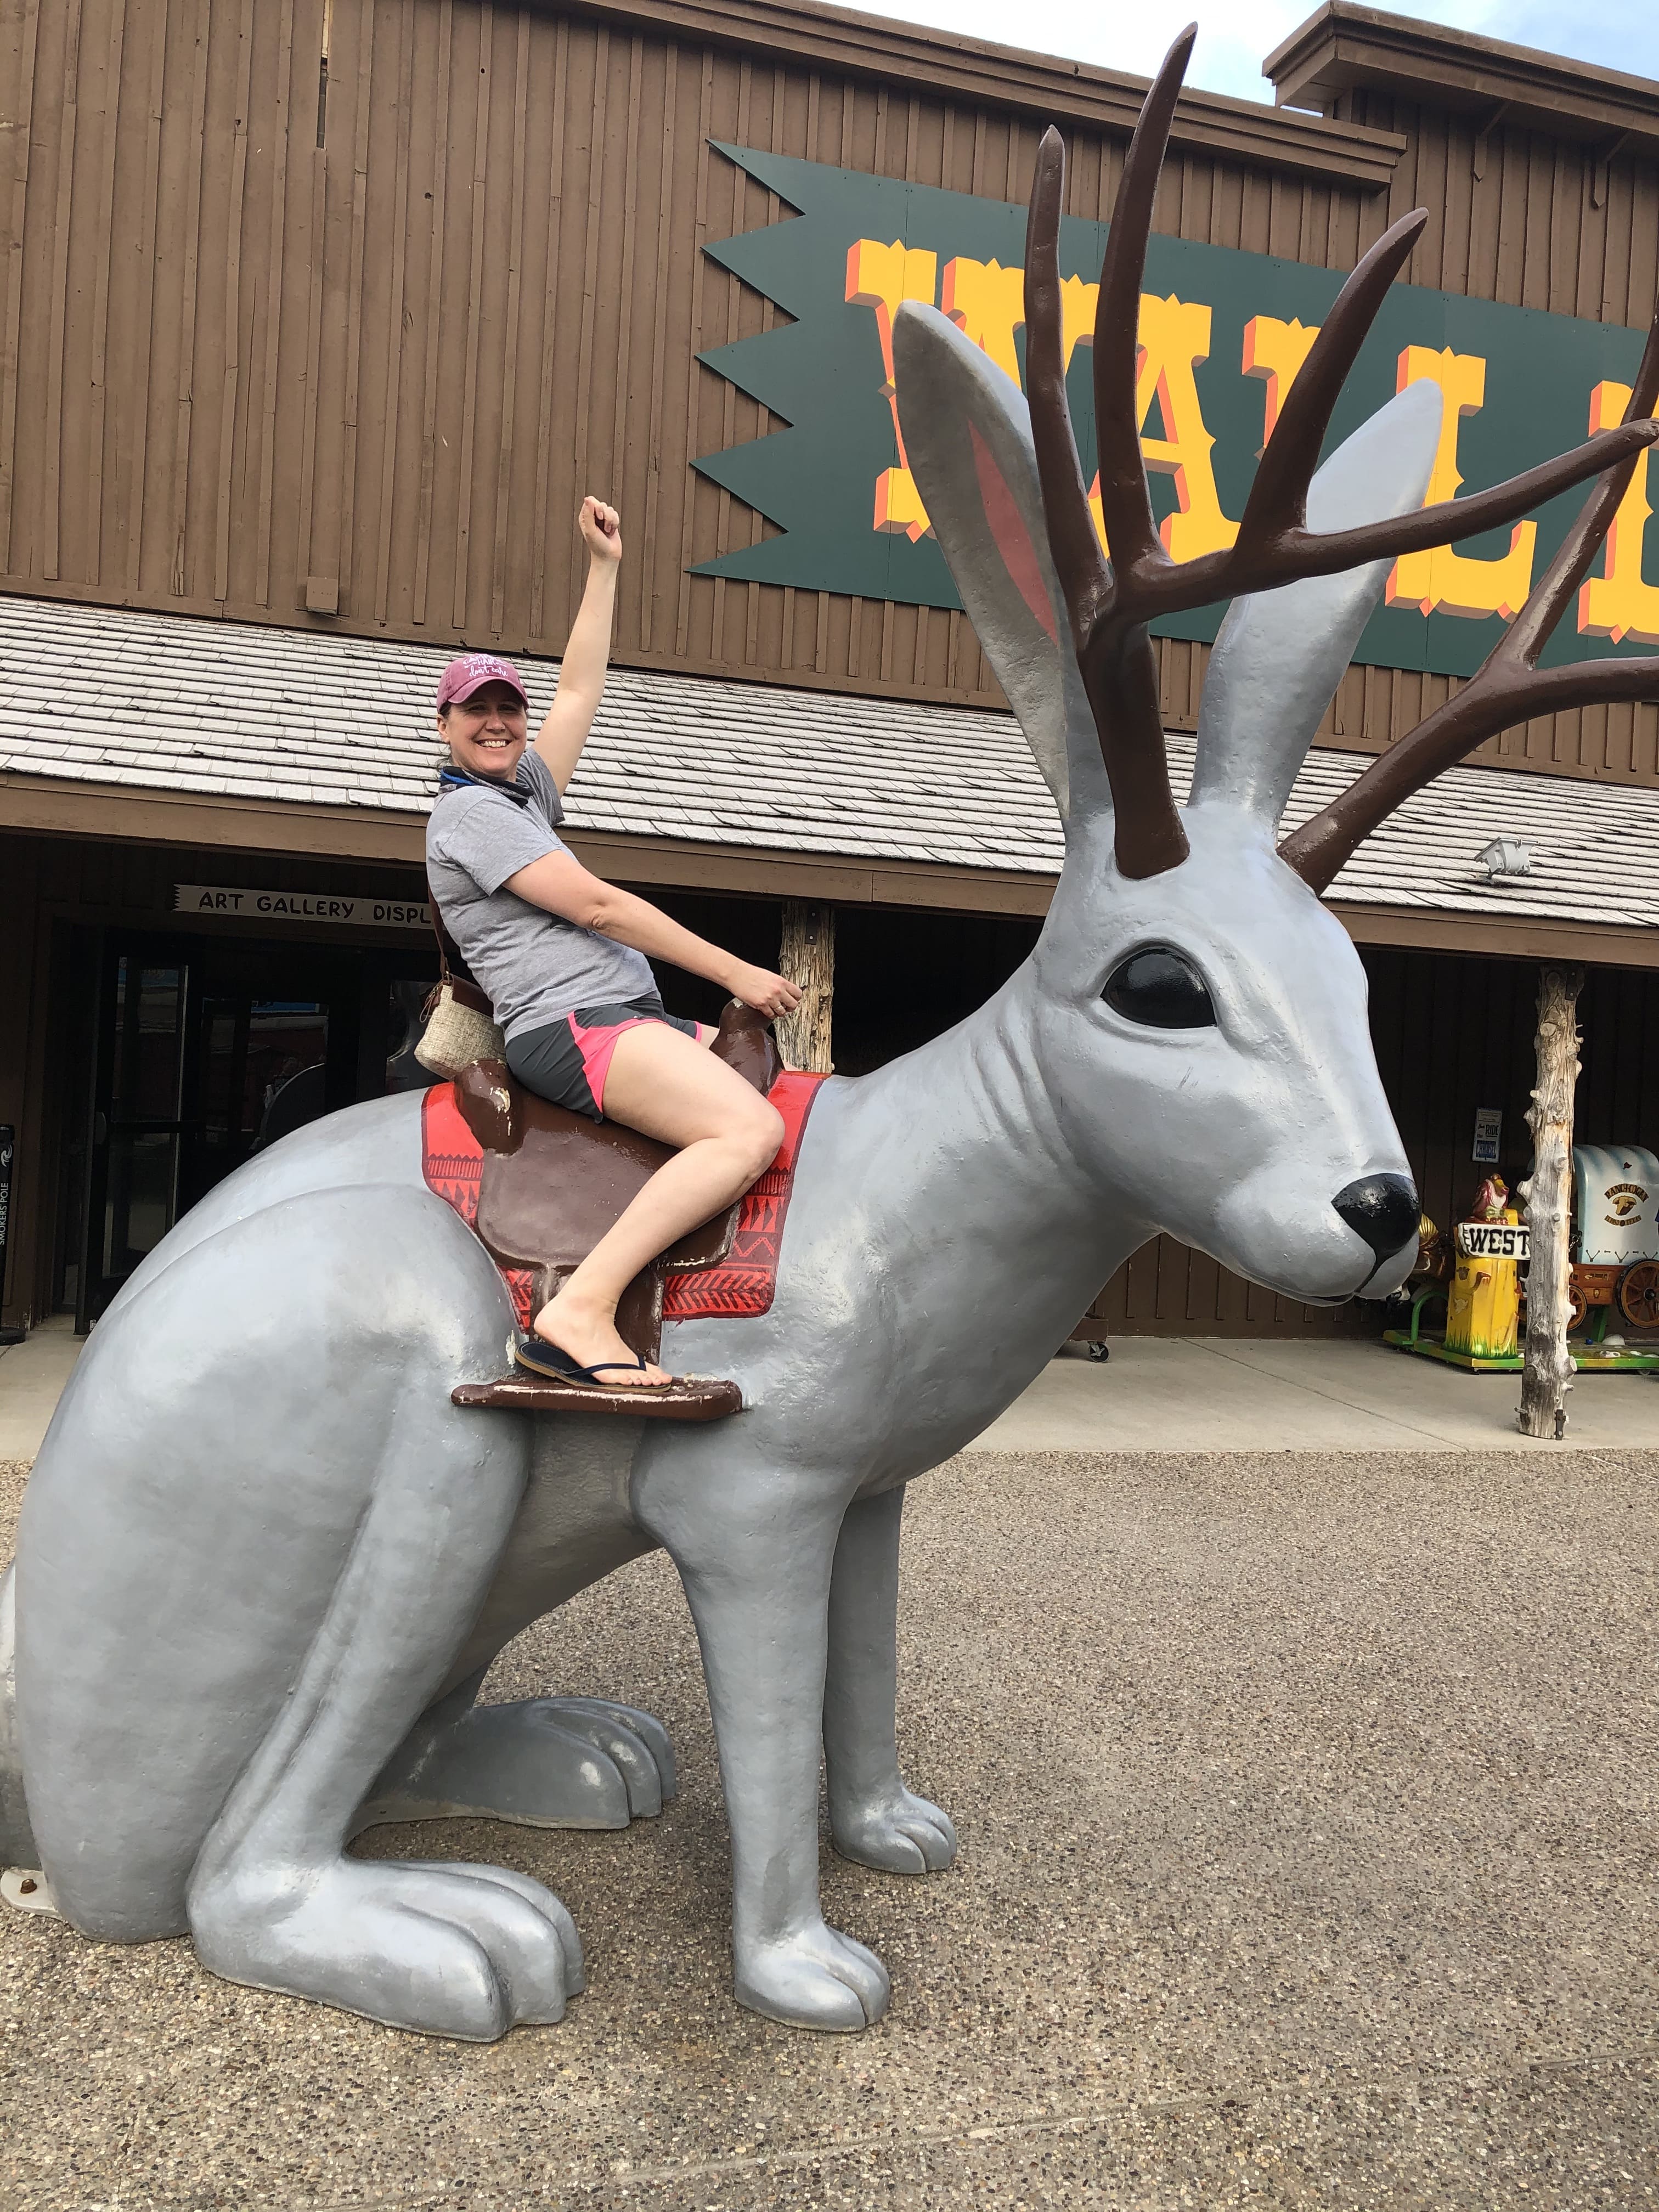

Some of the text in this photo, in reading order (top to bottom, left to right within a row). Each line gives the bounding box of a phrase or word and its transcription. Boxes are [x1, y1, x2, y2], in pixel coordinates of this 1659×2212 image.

[845, 238, 1538, 623] WAL
[491, 667, 508, 676] care
[199, 891, 432, 924] ART GALLERY DISPL
[1486, 1125, 1499, 1136] RIDE
[0, 1182, 9, 1203] POLE
[1469, 1228, 1530, 1256] WEST
